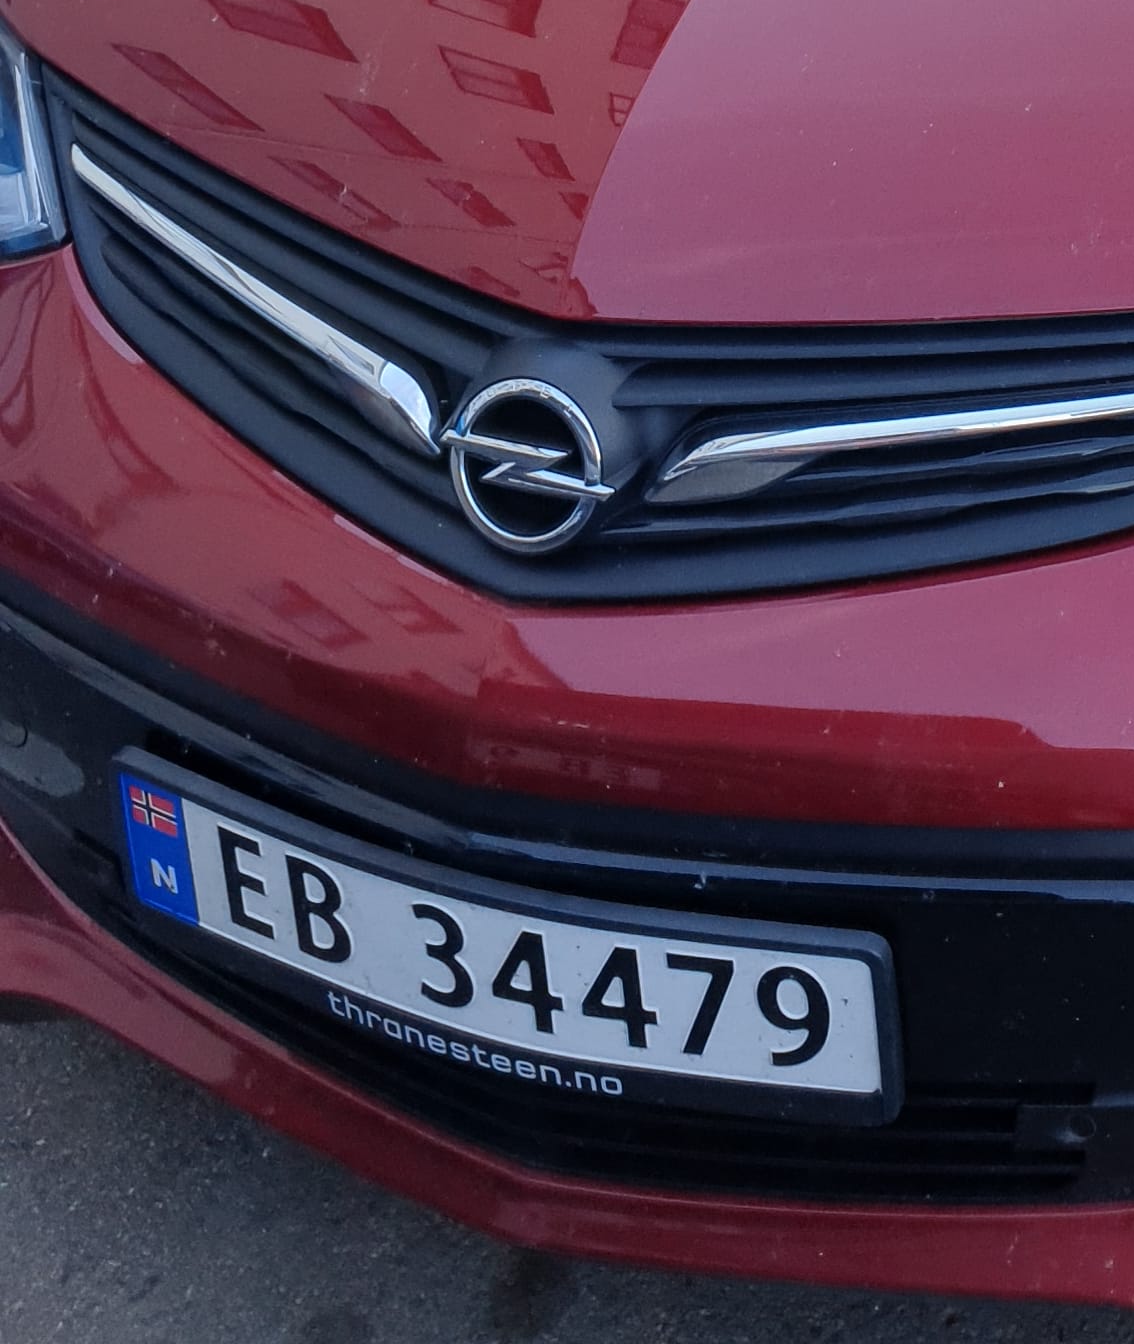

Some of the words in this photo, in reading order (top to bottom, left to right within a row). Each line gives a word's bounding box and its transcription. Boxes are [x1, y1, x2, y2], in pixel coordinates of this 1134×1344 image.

[151, 858, 178, 894] N
[217, 825, 352, 964] EB
[411, 903, 831, 1067] 34479
[326, 990, 624, 1096] thranesteen.no
